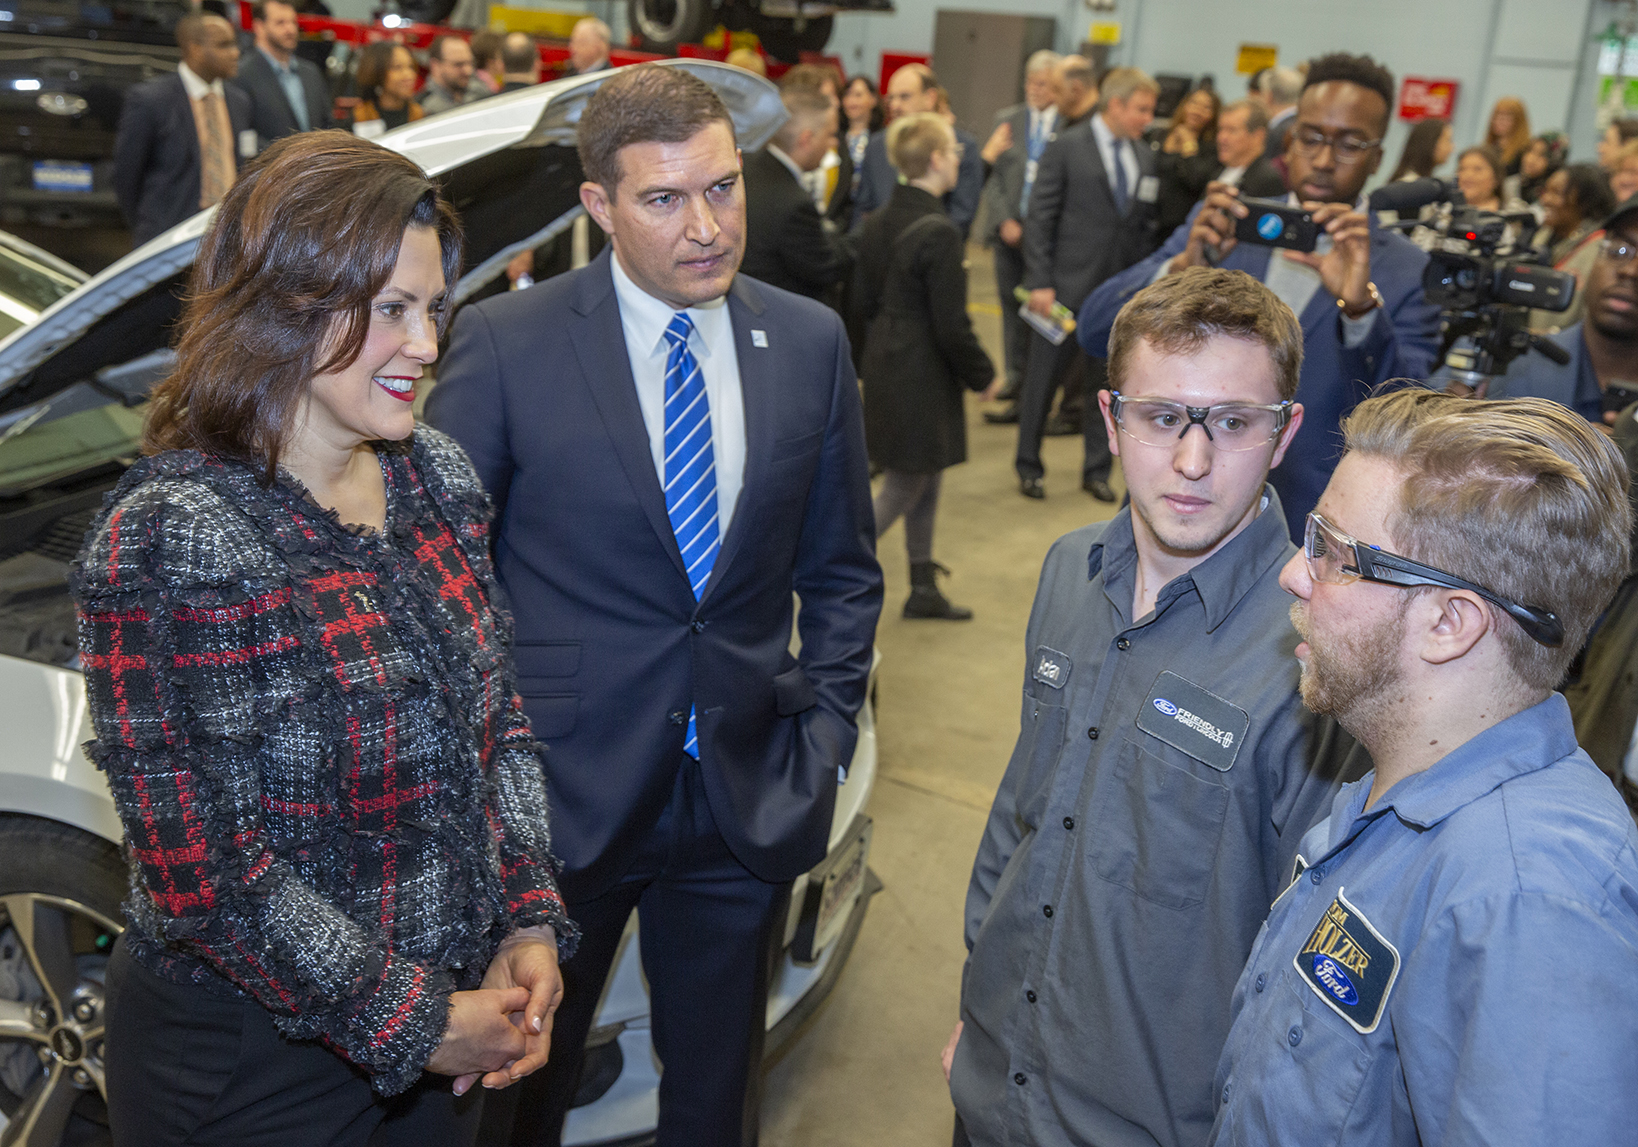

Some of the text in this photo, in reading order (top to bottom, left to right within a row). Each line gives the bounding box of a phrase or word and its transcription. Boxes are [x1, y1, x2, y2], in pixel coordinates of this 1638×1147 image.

[1178, 707, 1225, 737] FRIENDLY
[1302, 913, 1369, 979] HOLZER
[1315, 959, 1350, 999] Ford
